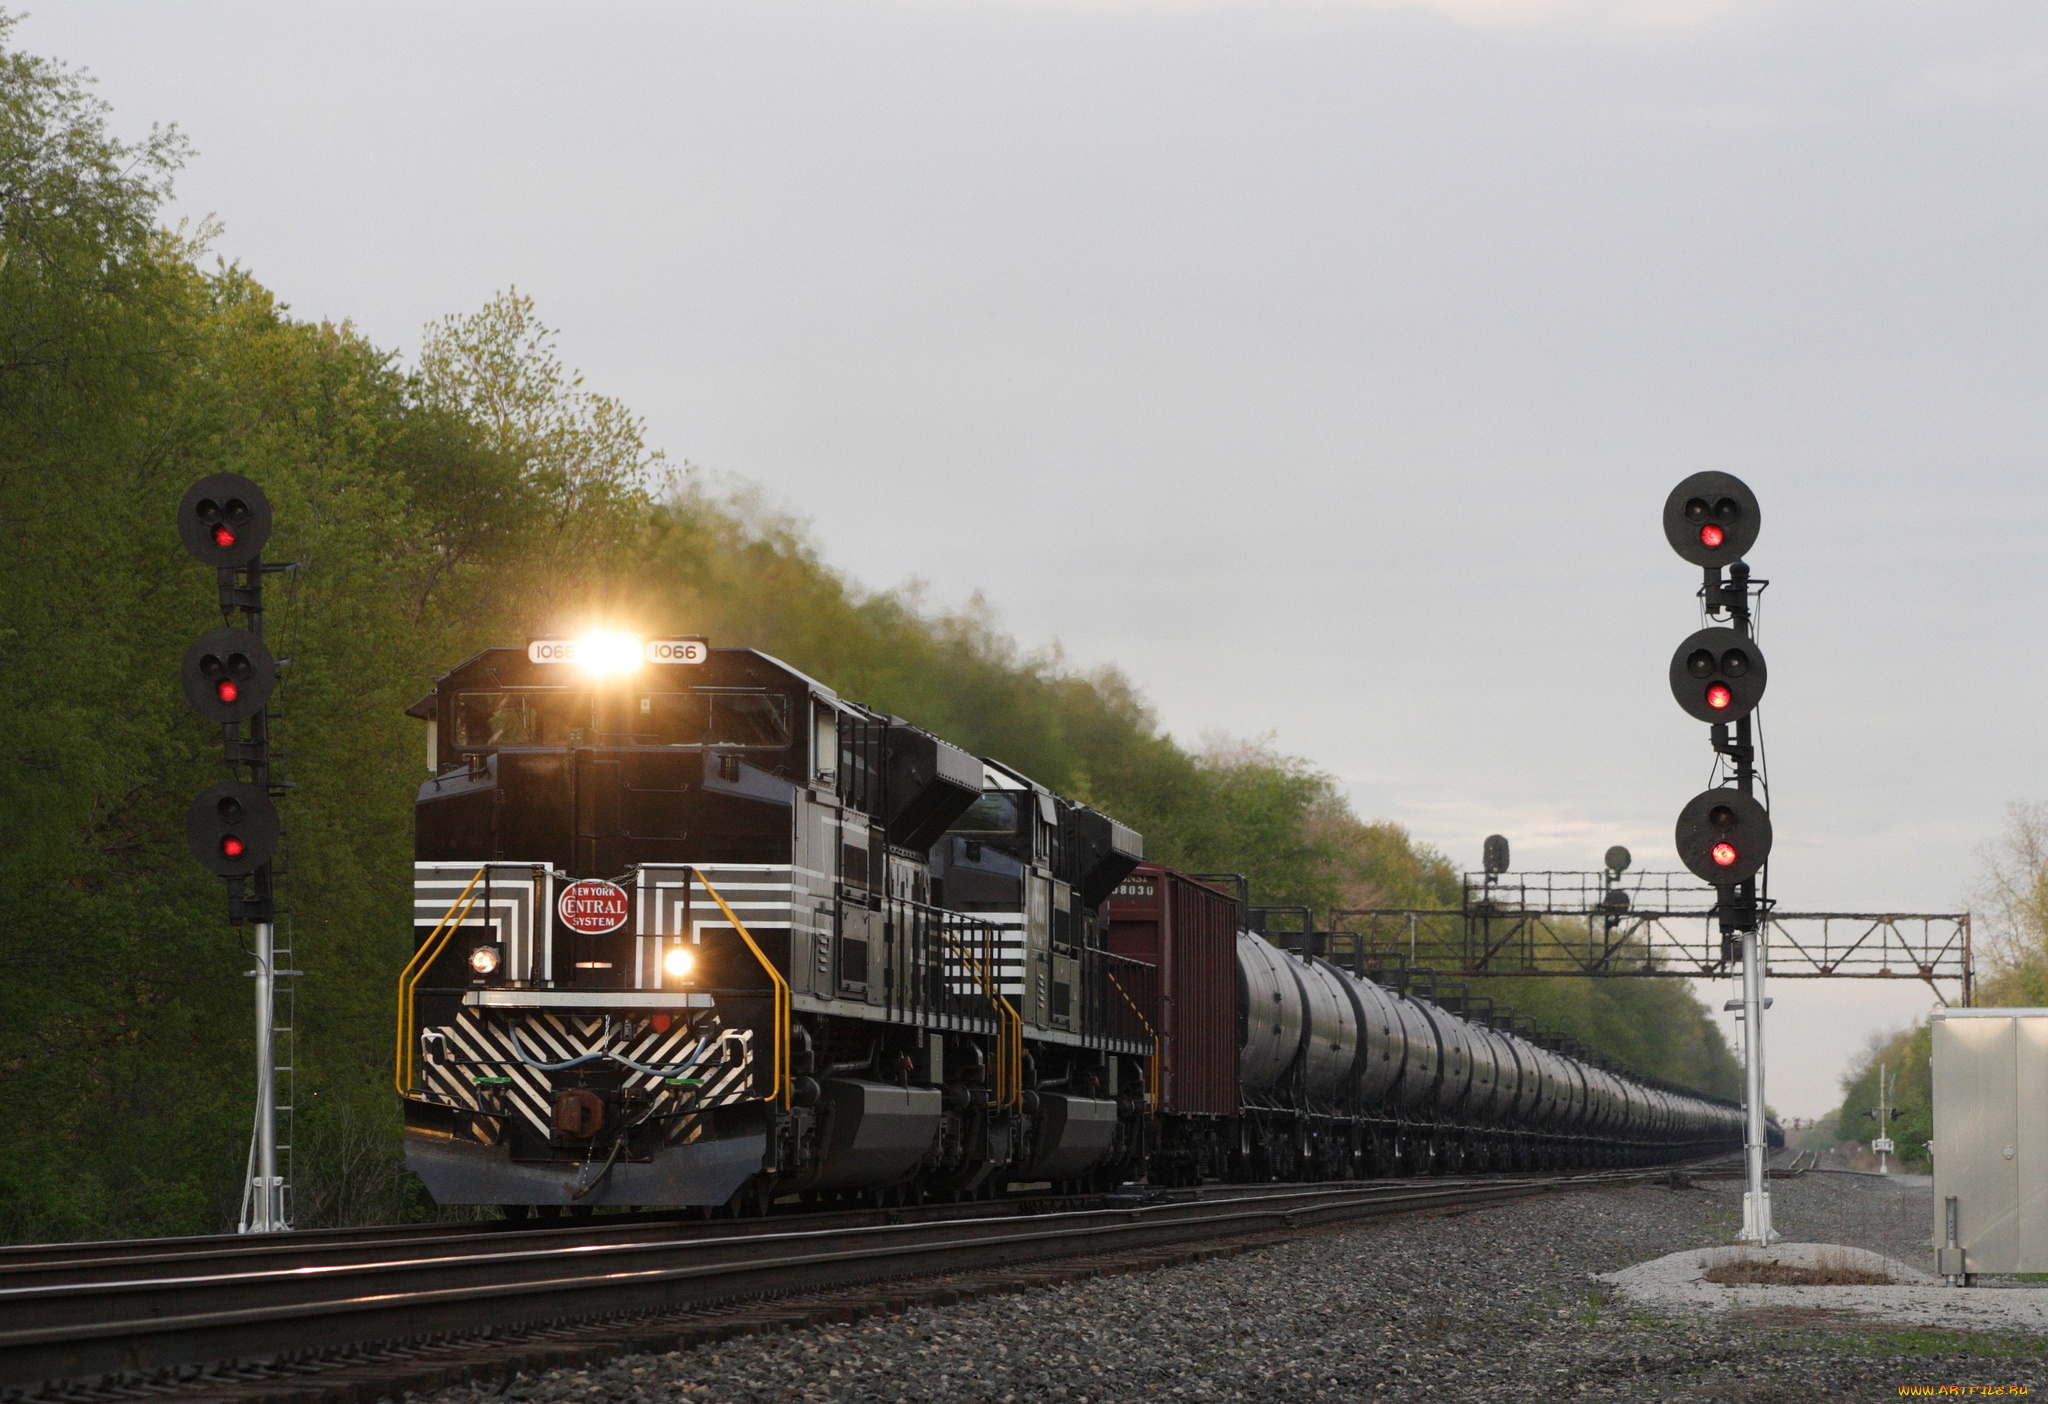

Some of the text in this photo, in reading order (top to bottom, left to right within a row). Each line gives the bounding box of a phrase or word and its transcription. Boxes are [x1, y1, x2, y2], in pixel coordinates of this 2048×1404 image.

[536, 645, 576, 659] 1066
[655, 645, 697, 659] 1066
[572, 887, 615, 896] NEW YORK
[561, 895, 626, 917] CENTRAL
[573, 917, 615, 926] SYSTEM
